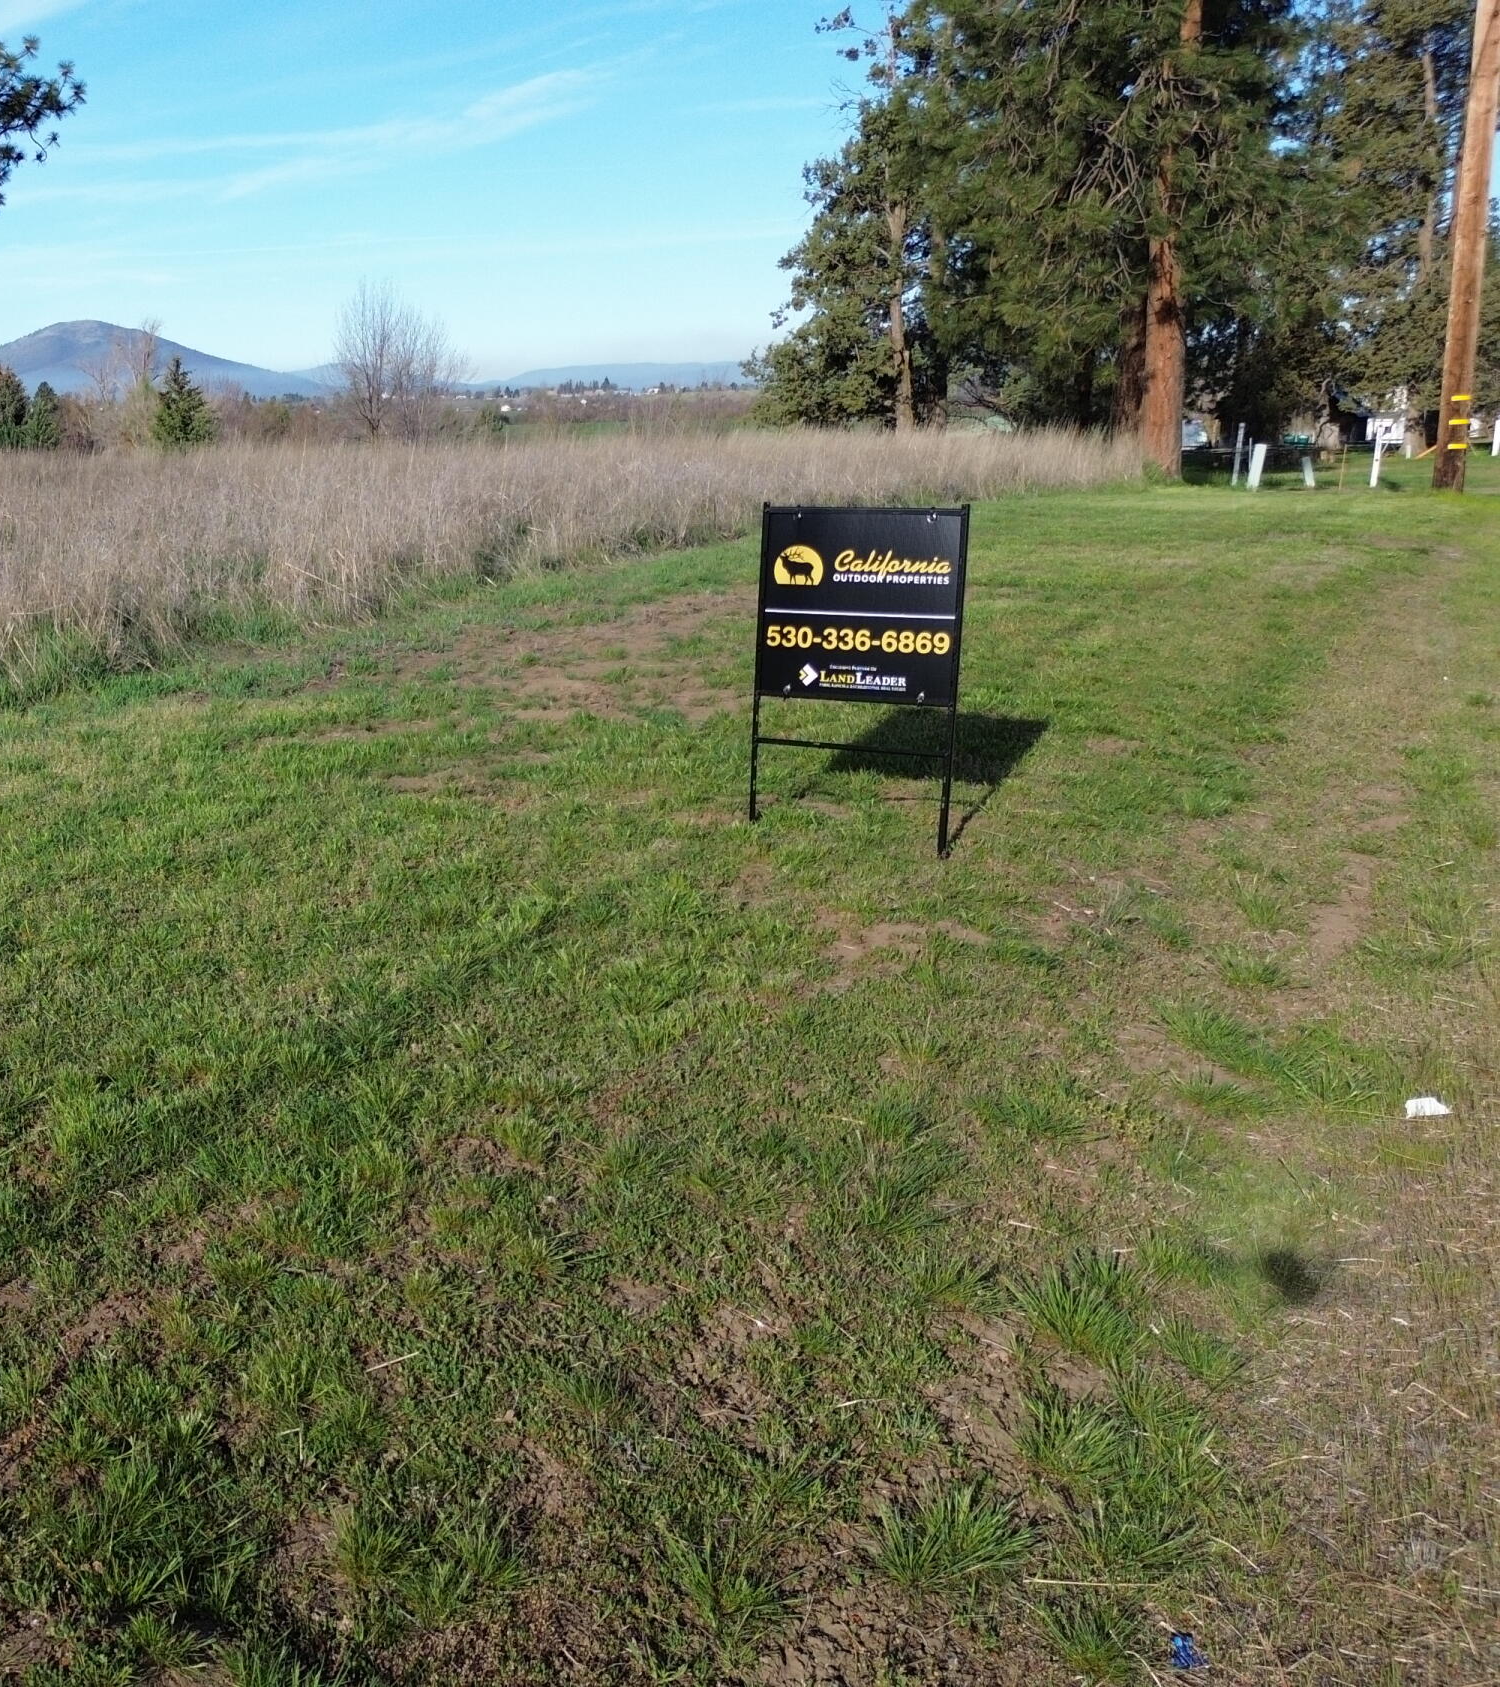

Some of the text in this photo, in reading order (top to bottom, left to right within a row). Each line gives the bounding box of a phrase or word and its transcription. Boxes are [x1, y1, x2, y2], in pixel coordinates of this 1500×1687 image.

[834, 549, 951, 578] California
[833, 573, 950, 585] OUTDOOR PROPERTIES
[766, 625, 951, 655] 530-336-6869
